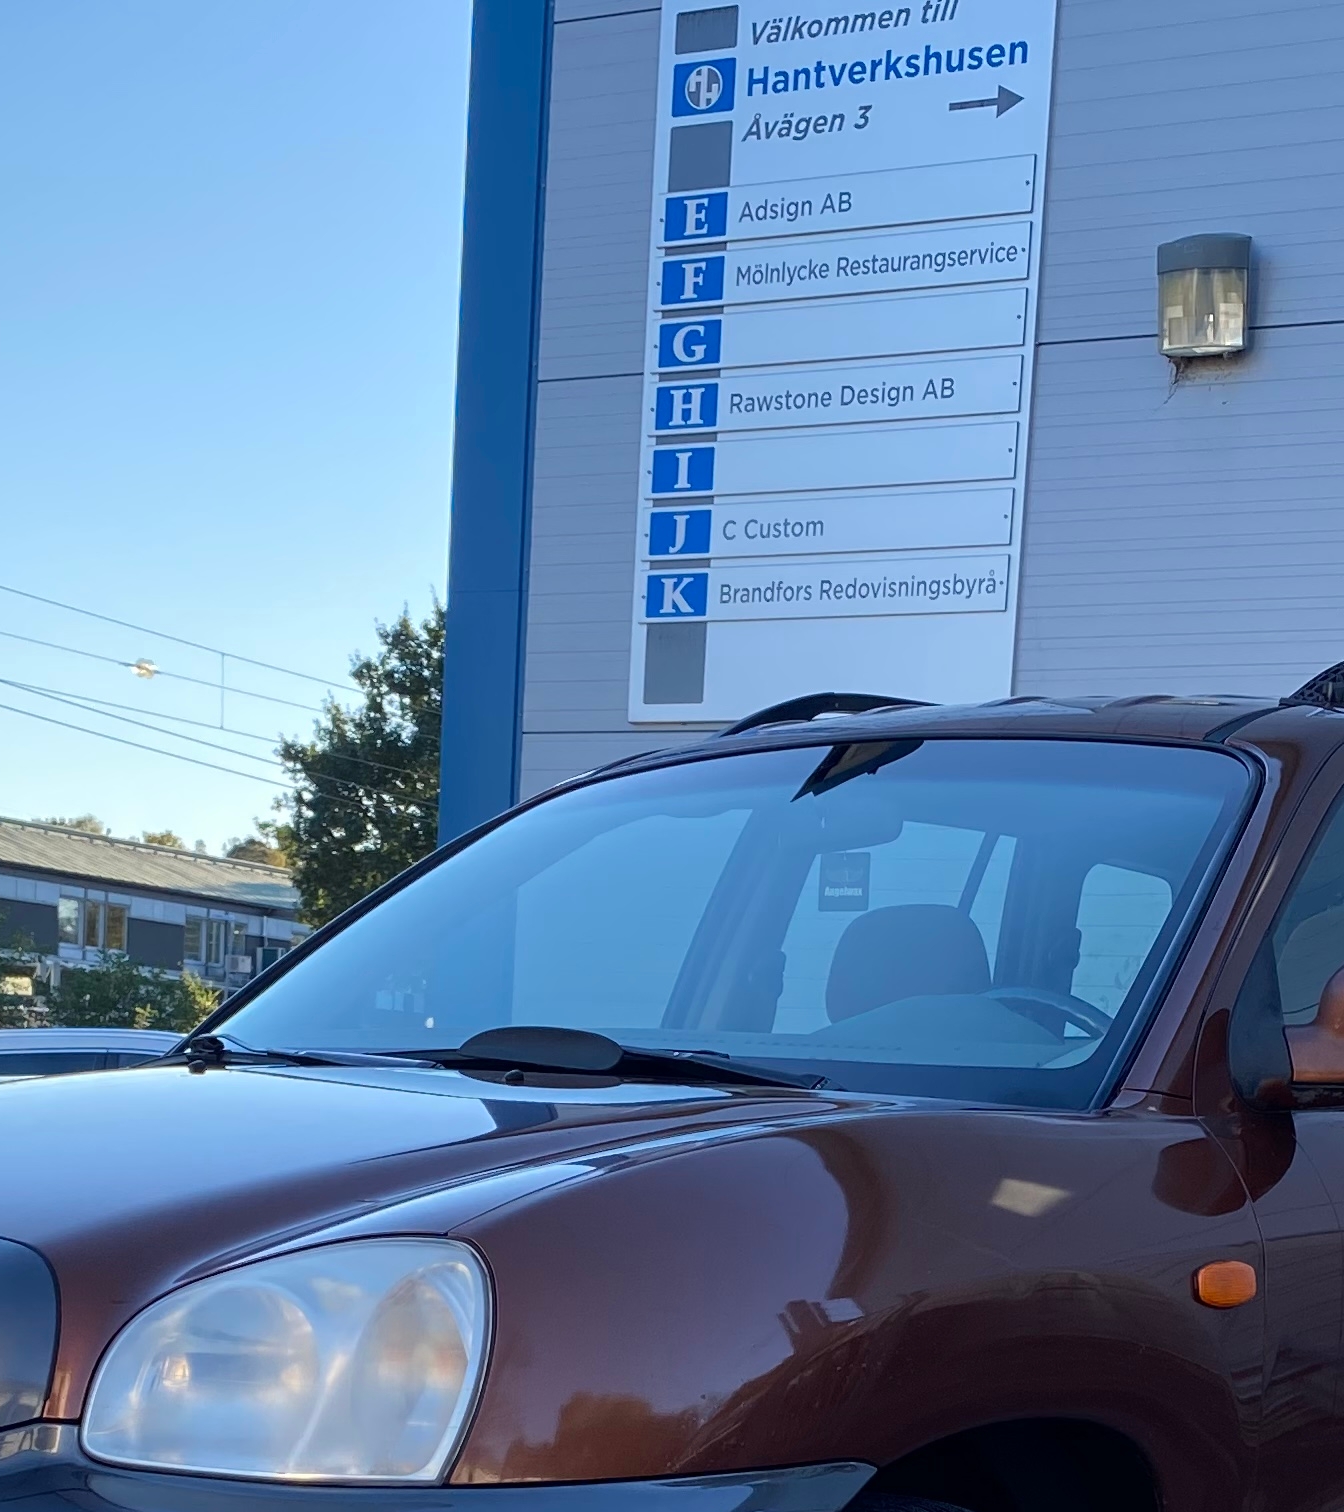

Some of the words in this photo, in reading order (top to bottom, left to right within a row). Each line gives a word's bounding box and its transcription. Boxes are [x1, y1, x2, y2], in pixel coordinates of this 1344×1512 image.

[751, 7, 911, 46] Välkommen
[921, 0, 958, 24] till
[747, 40, 1029, 97] Hantverkshusen
[741, 112, 846, 142] Åvägen
[854, 104, 873, 129] 3
[683, 198, 710, 236] E
[739, 196, 813, 223] Adsign
[820, 192, 852, 215] AB
[680, 262, 707, 300] F
[735, 260, 830, 287] Mölnlycke
[836, 242, 1018, 277] Restaurangservice
[673, 325, 707, 362] G
[668, 388, 705, 426] H
[729, 388, 832, 415] Rawstone
[840, 381, 914, 407] Design
[922, 378, 955, 400] AB
[674, 452, 693, 489] I
[669, 515, 690, 554] J
[722, 520, 736, 541] C
[744, 517, 825, 540] Custom
[659, 577, 694, 613] K
[719, 580, 812, 605] Brandfors
[820, 569, 997, 602] Redovisningsbyrå
[824, 886, 863, 898] Angelwax
